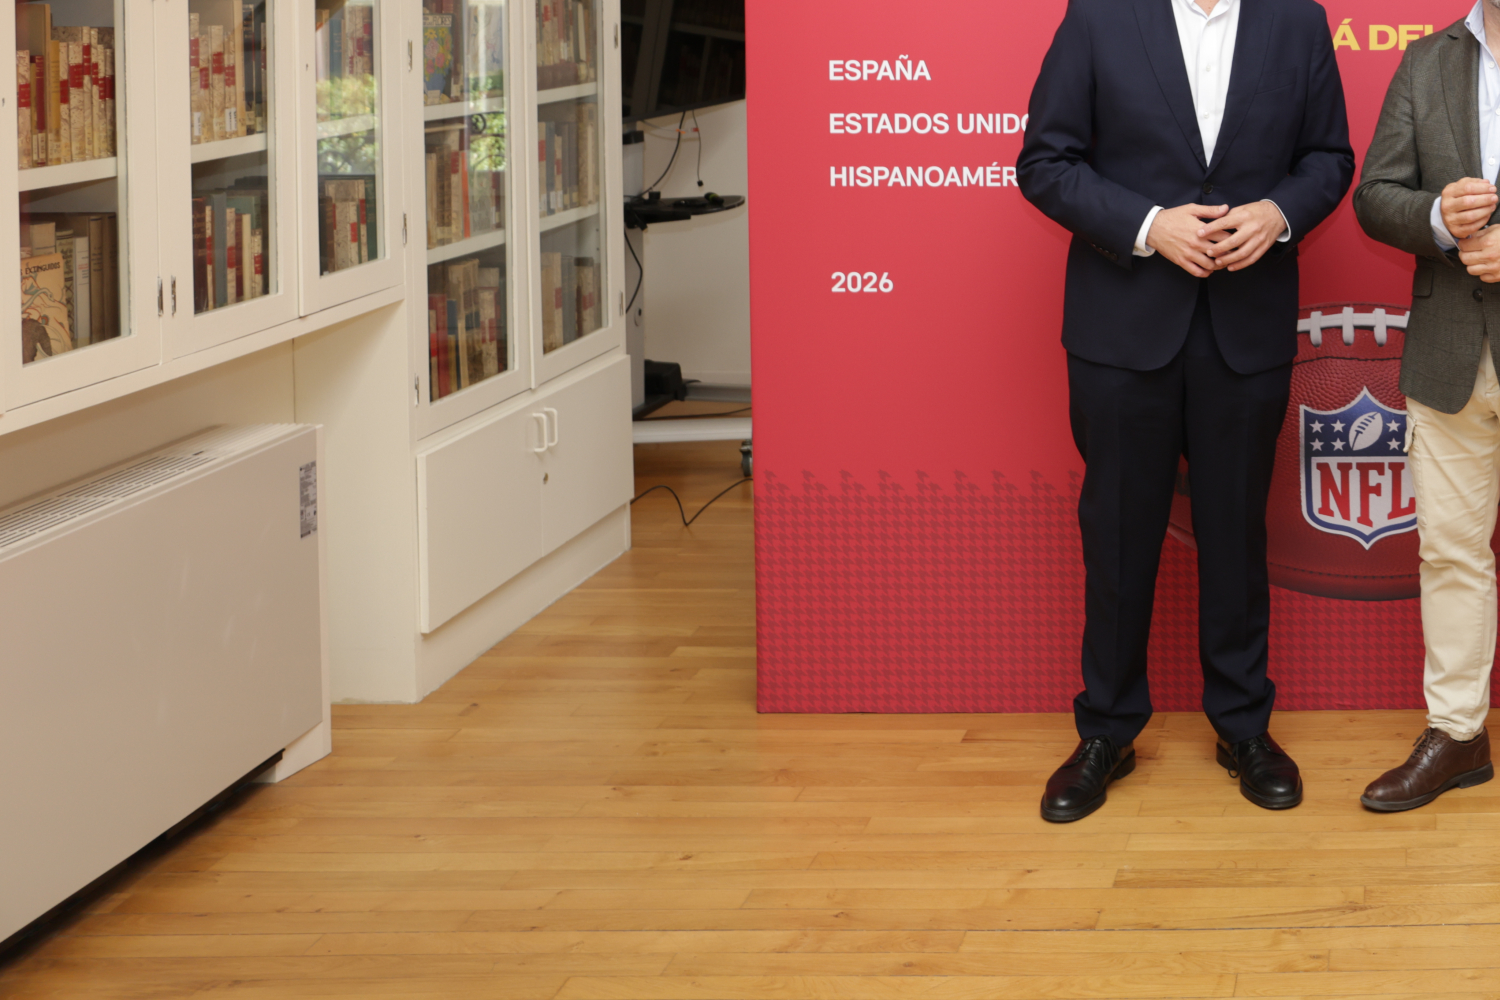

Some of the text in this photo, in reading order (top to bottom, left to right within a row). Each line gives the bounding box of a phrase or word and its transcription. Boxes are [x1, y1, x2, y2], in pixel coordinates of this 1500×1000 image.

[828, 54, 932, 81] ESPAÑA
[828, 112, 1029, 135] ESTADOS UNID
[829, 161, 1019, 187] HISPANOAMÉR
[831, 271, 894, 293] 2026
[1316, 461, 1417, 528] NFL
